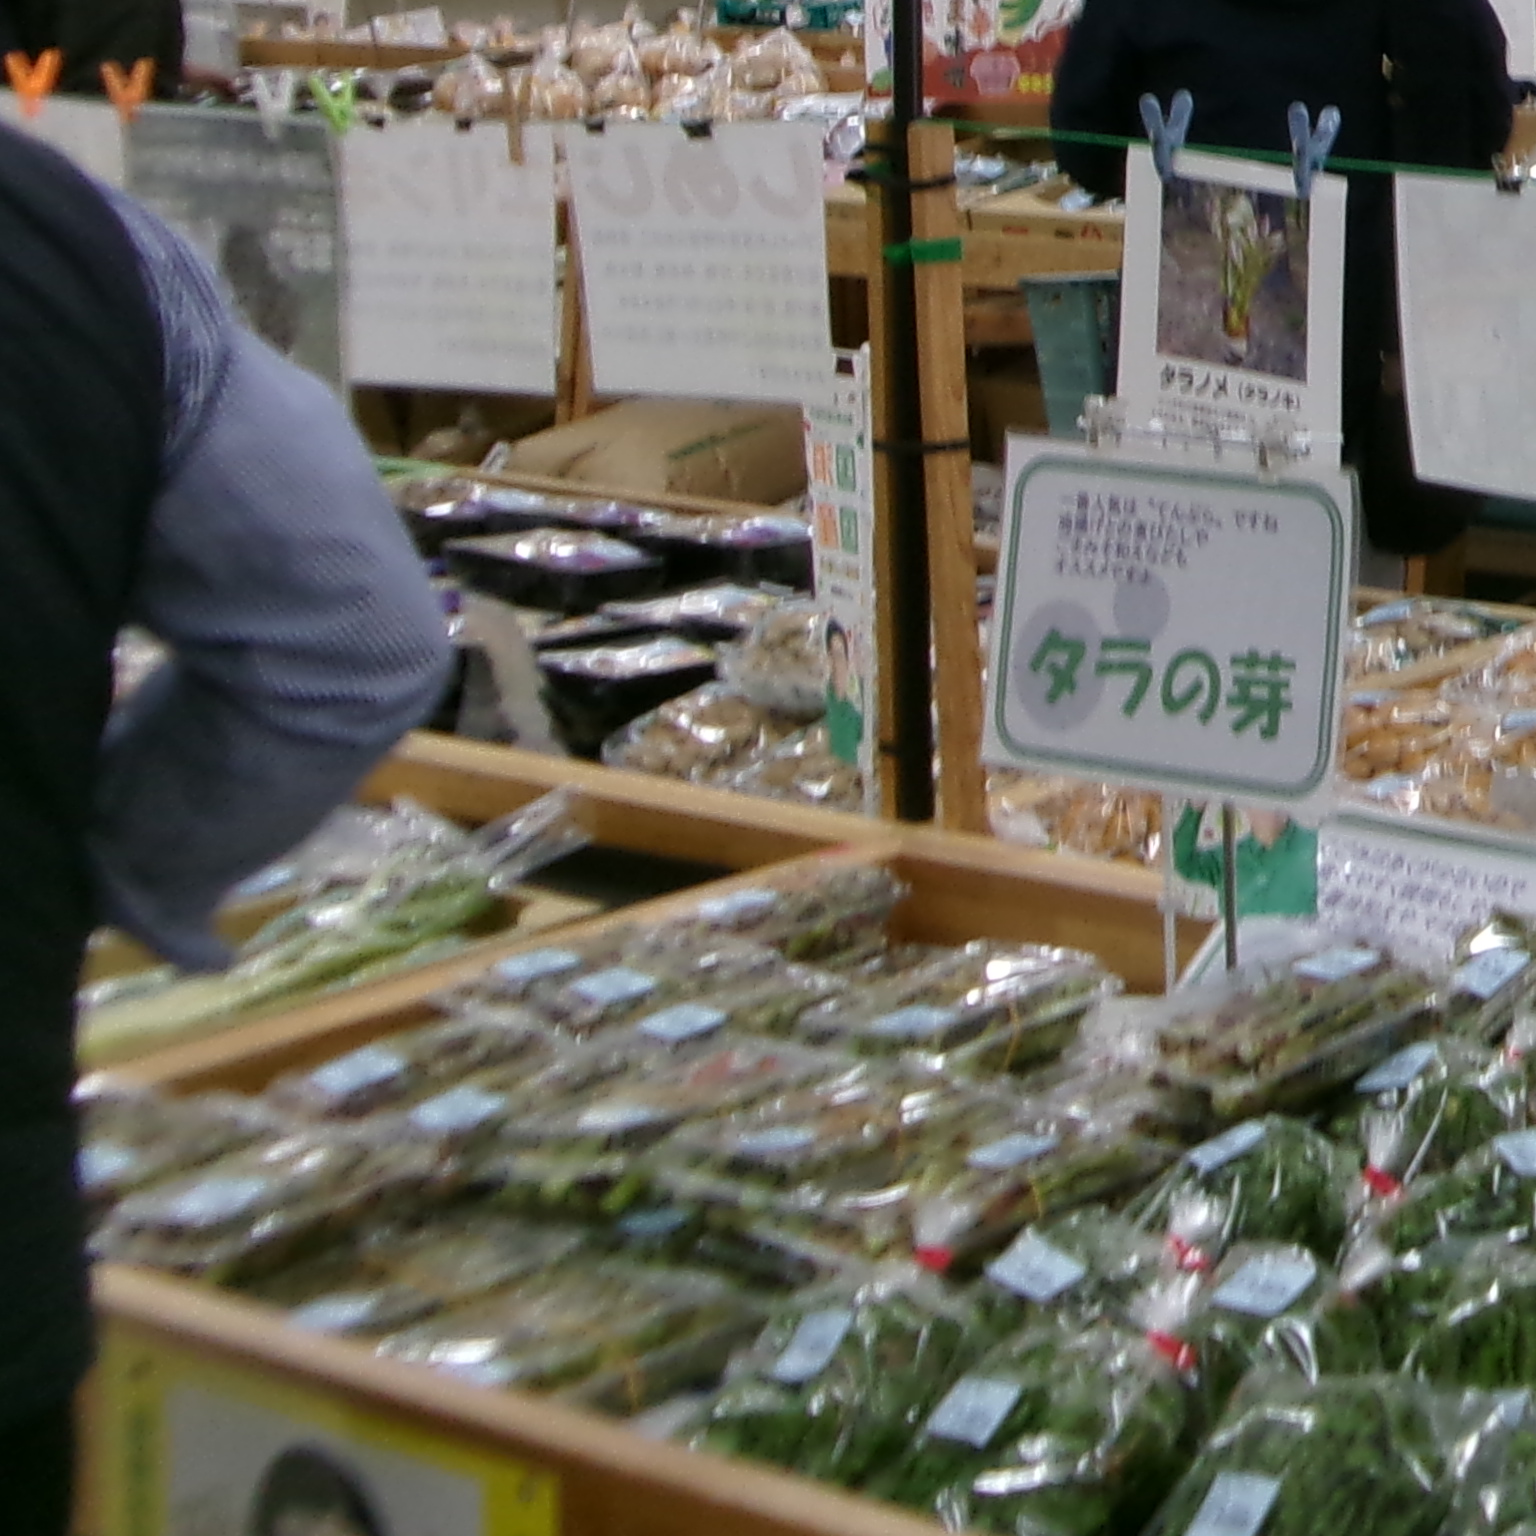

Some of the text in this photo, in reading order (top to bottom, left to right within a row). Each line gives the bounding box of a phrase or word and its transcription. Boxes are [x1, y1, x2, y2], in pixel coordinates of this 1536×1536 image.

[1160, 363, 1229, 401] タラノメ
[1029, 627, 1298, 743] タラの芽
